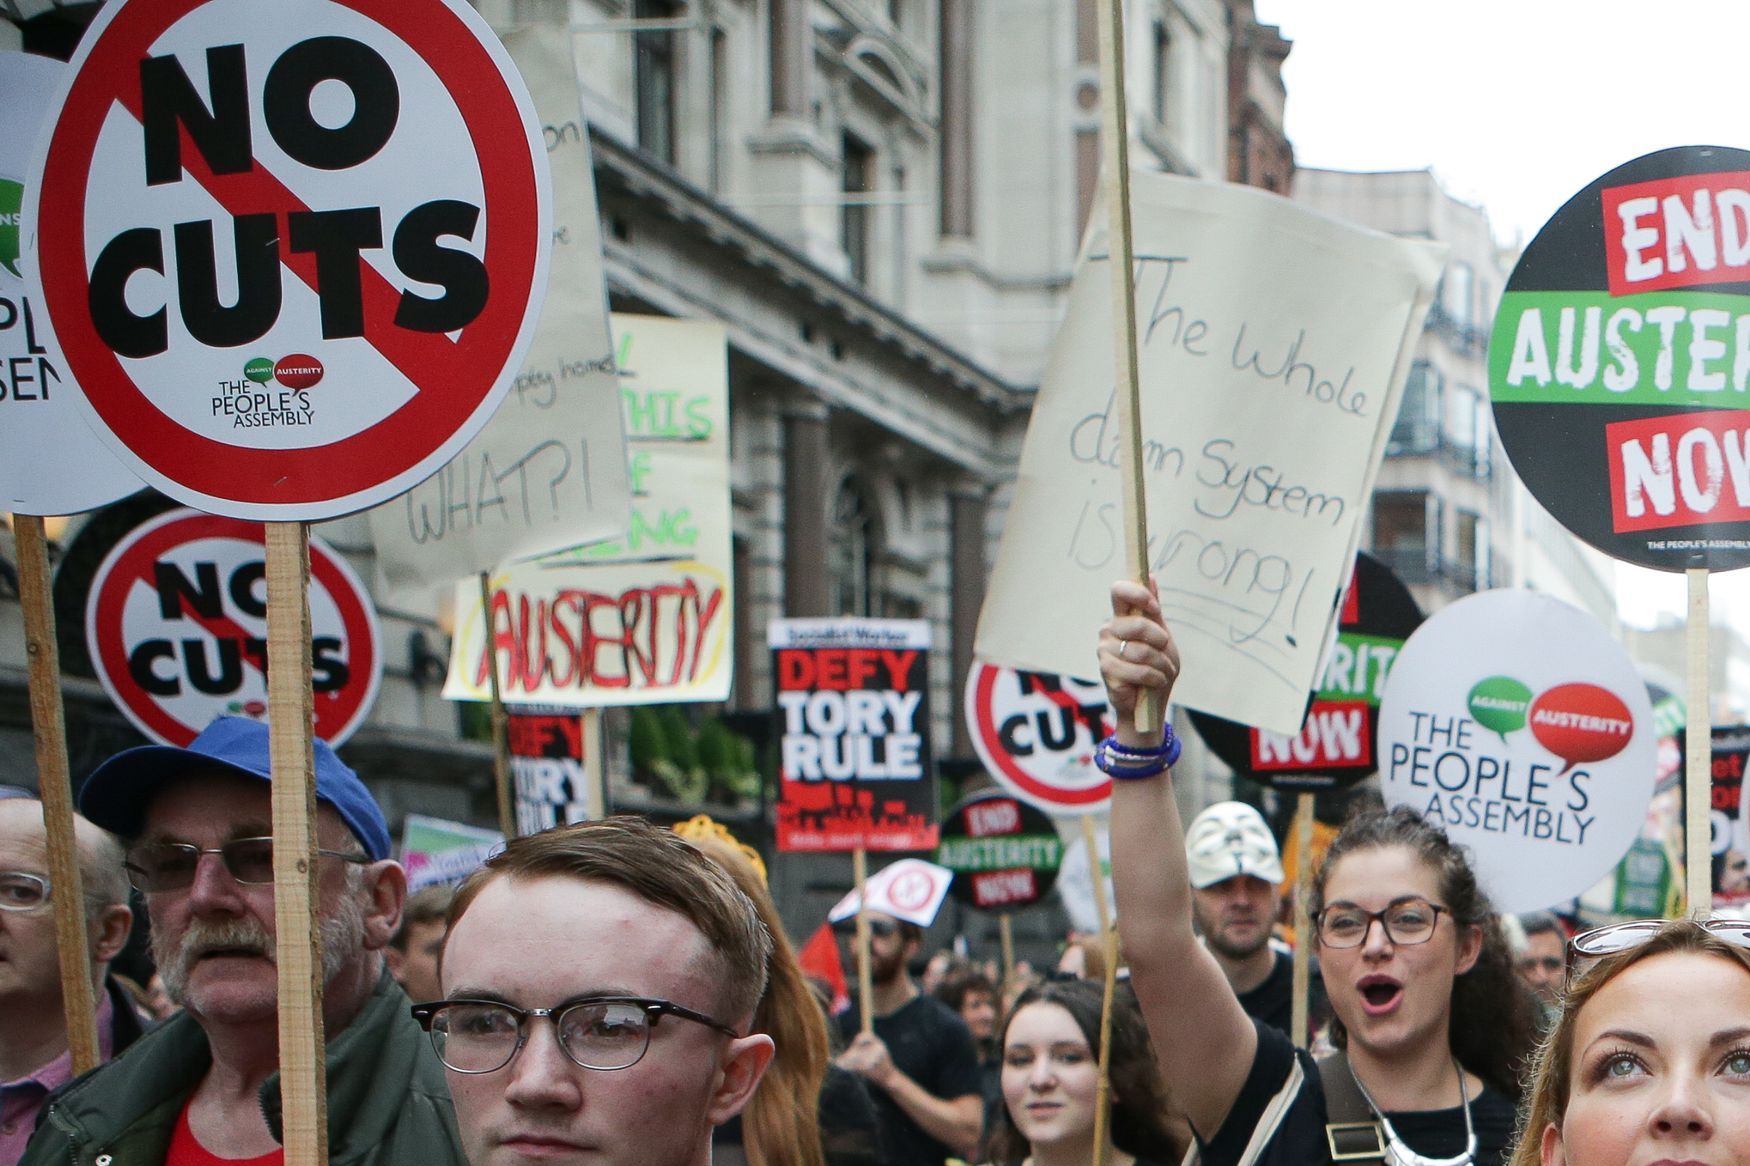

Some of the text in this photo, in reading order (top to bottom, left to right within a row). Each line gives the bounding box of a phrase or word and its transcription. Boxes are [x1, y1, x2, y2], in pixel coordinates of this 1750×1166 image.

[139, 36, 400, 186] NO
[88, 199, 489, 359] CUTS
[219, 380, 251, 395] THE
[277, 366, 322, 376] AUSTERITY
[234, 410, 315, 428] ASSEMBLY
[1647, 541, 1665, 550] THE
[778, 648, 918, 692] DEFY
[778, 689, 922, 737] TORY
[999, 702, 1108, 756] CUT
[1409, 710, 1473, 749] THE
[1470, 695, 1528, 713] AGAINST
[1534, 708, 1631, 736] AUSTERITY
[782, 733, 923, 781] RULE
[1258, 709, 1362, 764] NOW
[1423, 792, 1596, 845] ASSEMBLY
